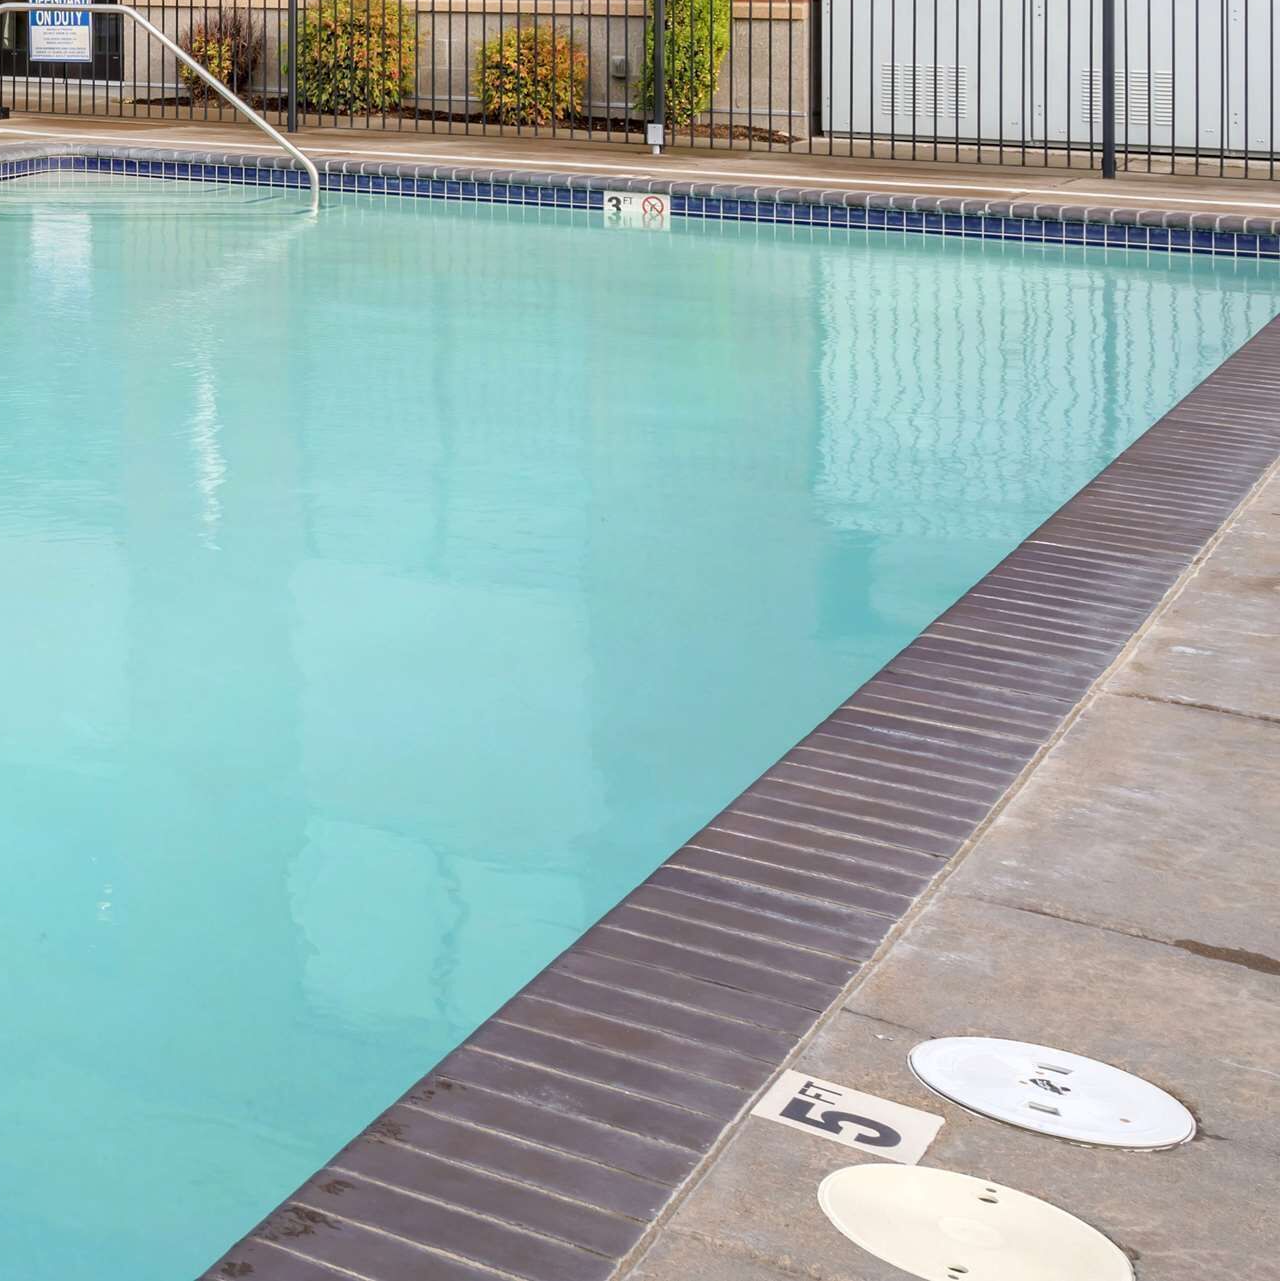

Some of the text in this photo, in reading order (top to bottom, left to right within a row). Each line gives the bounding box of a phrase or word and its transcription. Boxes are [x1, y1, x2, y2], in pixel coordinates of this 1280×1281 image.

[36, 10, 82, 26] ON DUTY
[608, 196, 632, 211] 3 FT
[779, 1081, 902, 1148] 5 FT
